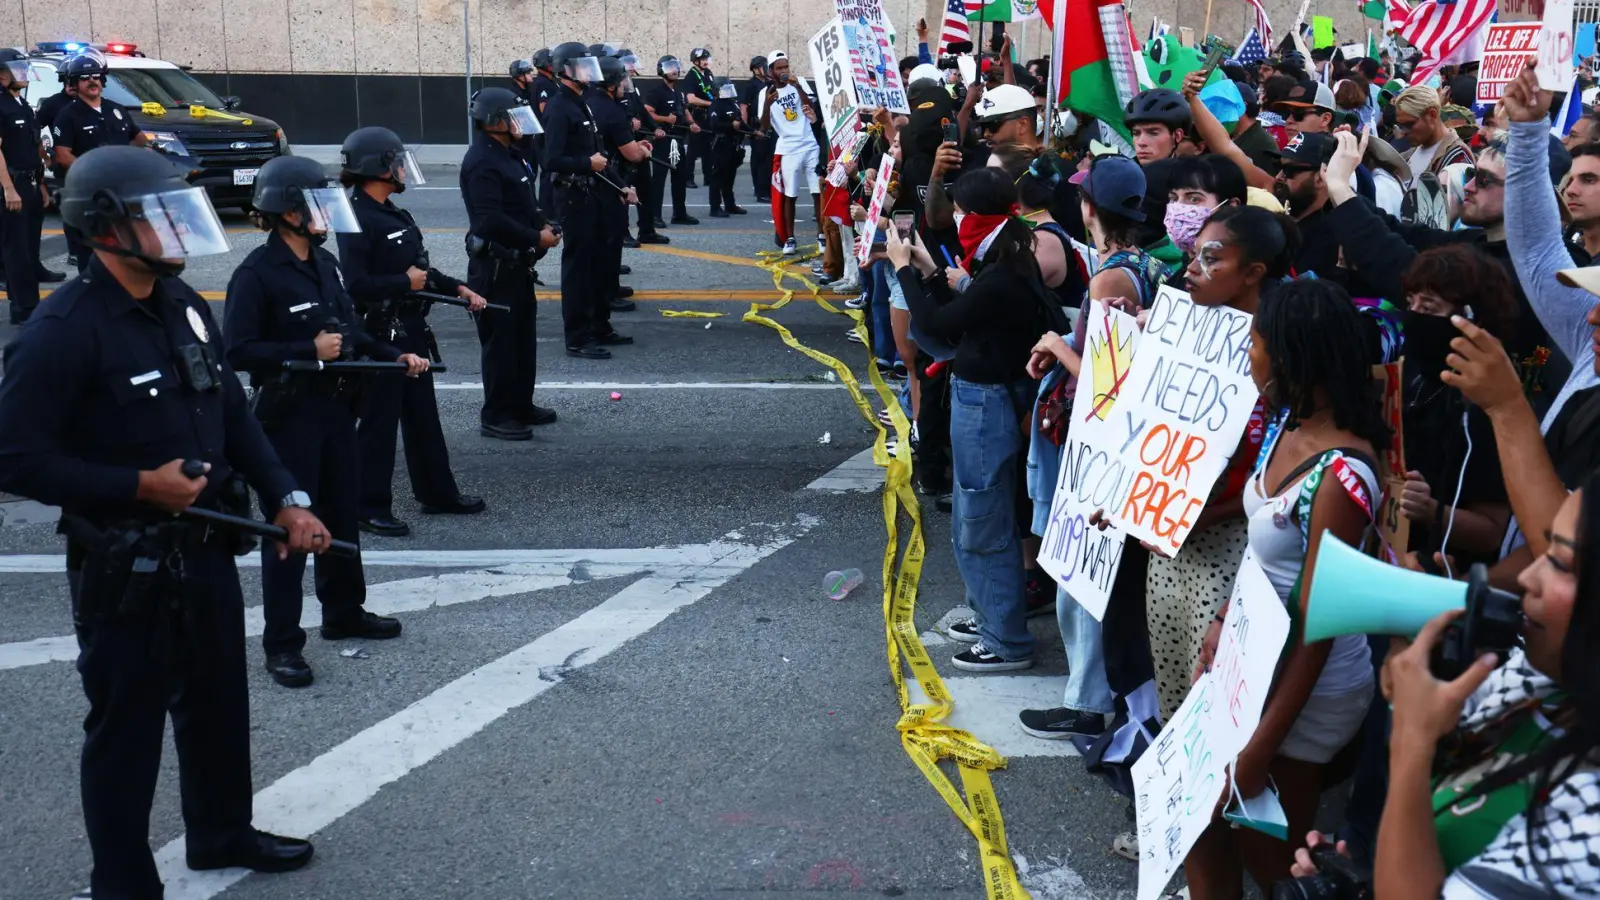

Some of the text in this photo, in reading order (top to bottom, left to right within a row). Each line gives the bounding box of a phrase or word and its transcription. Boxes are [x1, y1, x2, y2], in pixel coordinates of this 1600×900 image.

[815, 25, 839, 61] YES
[1509, 28, 1533, 50] OFF
[824, 61, 842, 95] 50
[1481, 54, 1533, 79] PROPERT
[776, 92, 796, 105] WHAT
[1146, 292, 1252, 376] DEMOCRA
[1141, 356, 1238, 432] NEEDS
[1119, 411, 1206, 489] YOUR
[1077, 450, 1203, 548] COURAGE
[1044, 493, 1085, 582] King
[1081, 527, 1124, 593] WAY
[1156, 727, 1177, 776] ALL
[1166, 769, 1183, 816] THE
